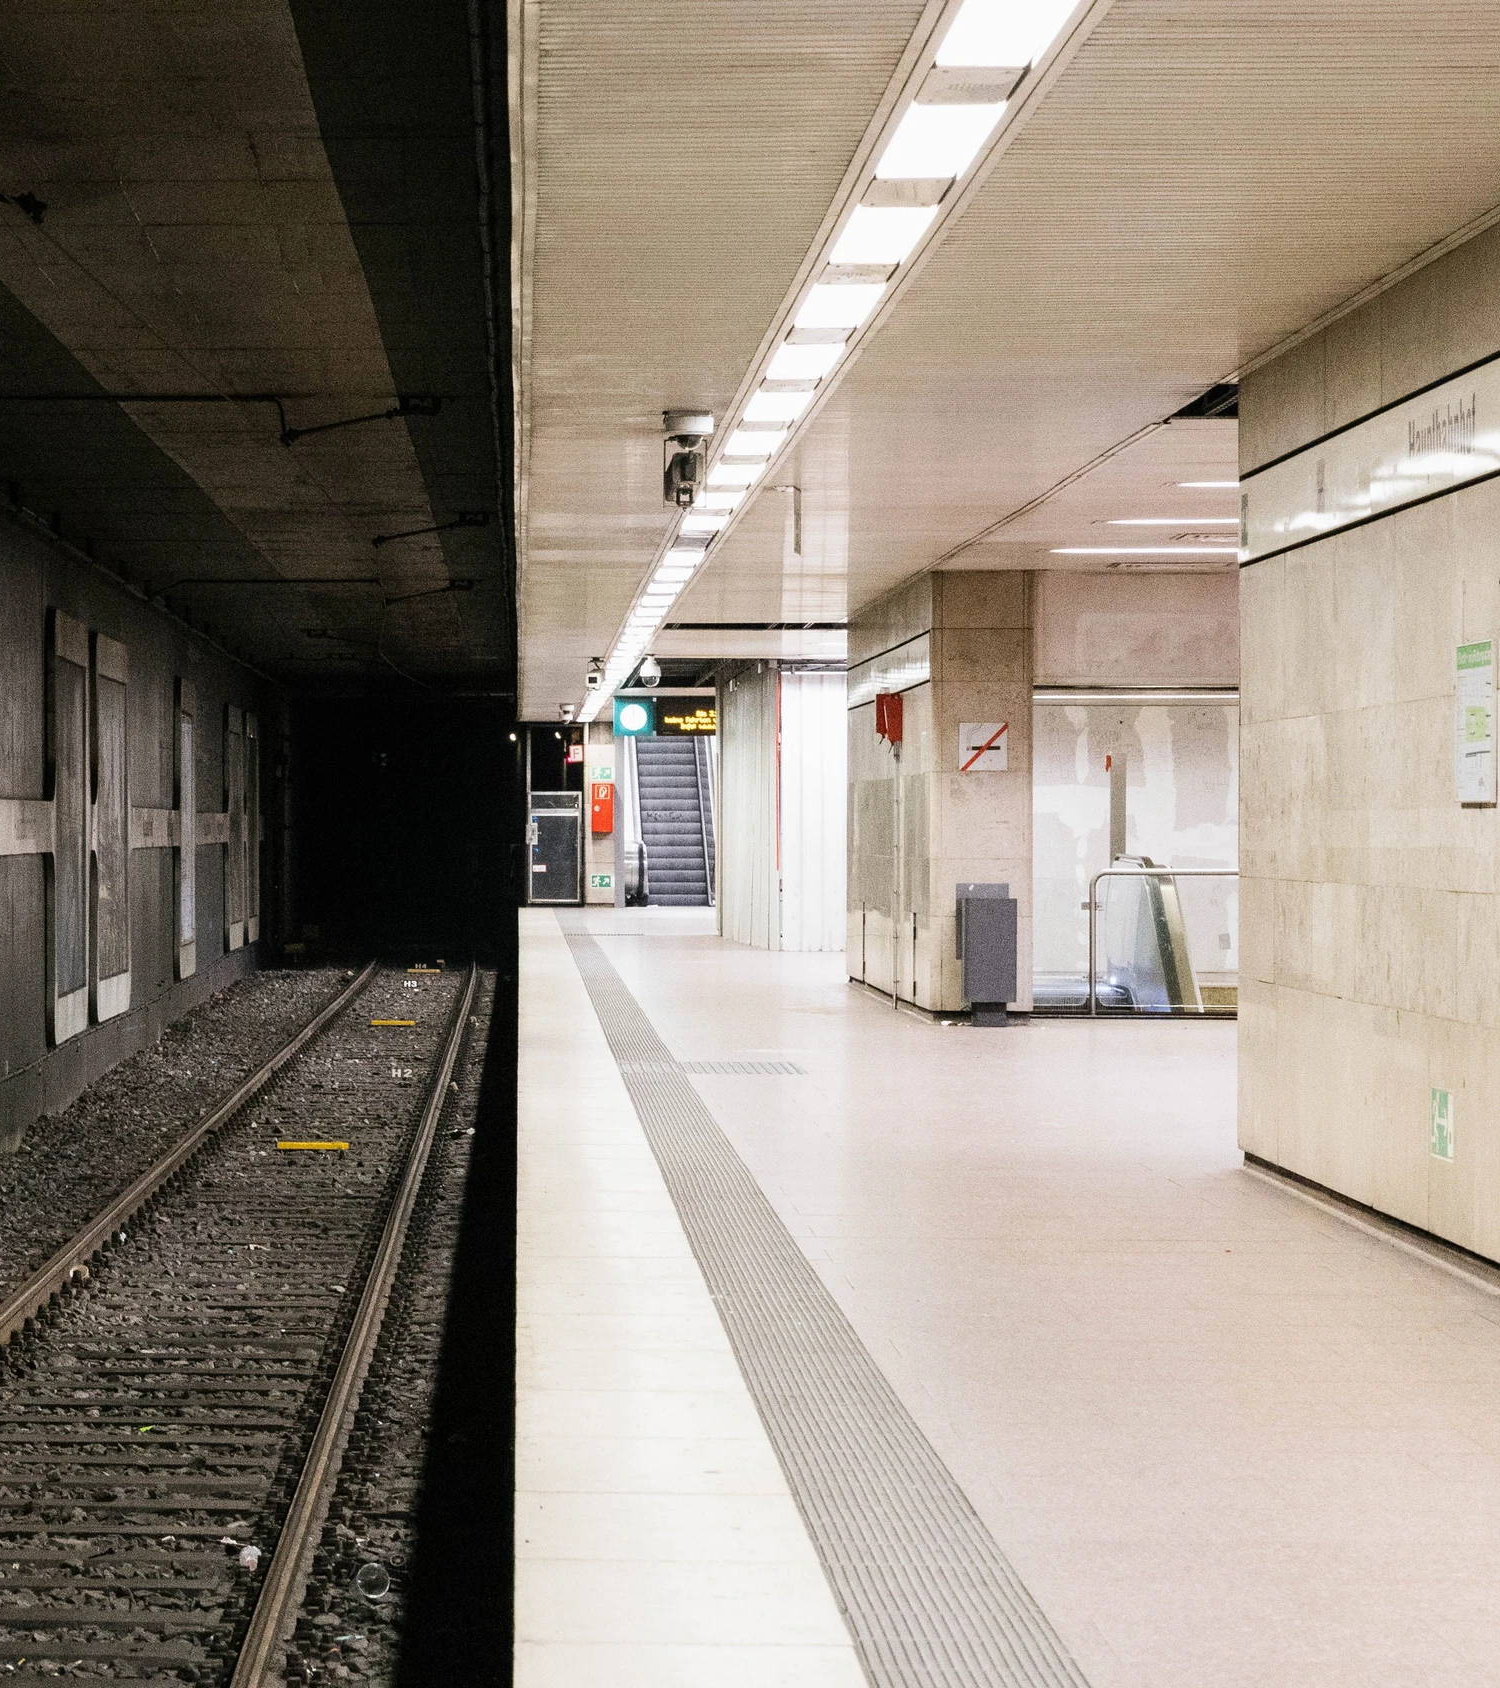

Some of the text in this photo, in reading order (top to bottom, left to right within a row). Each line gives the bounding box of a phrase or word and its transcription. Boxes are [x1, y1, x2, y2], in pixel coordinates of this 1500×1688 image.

[572, 747, 580, 760] F
[403, 980, 418, 988] H3
[391, 1068, 413, 1078] H2
